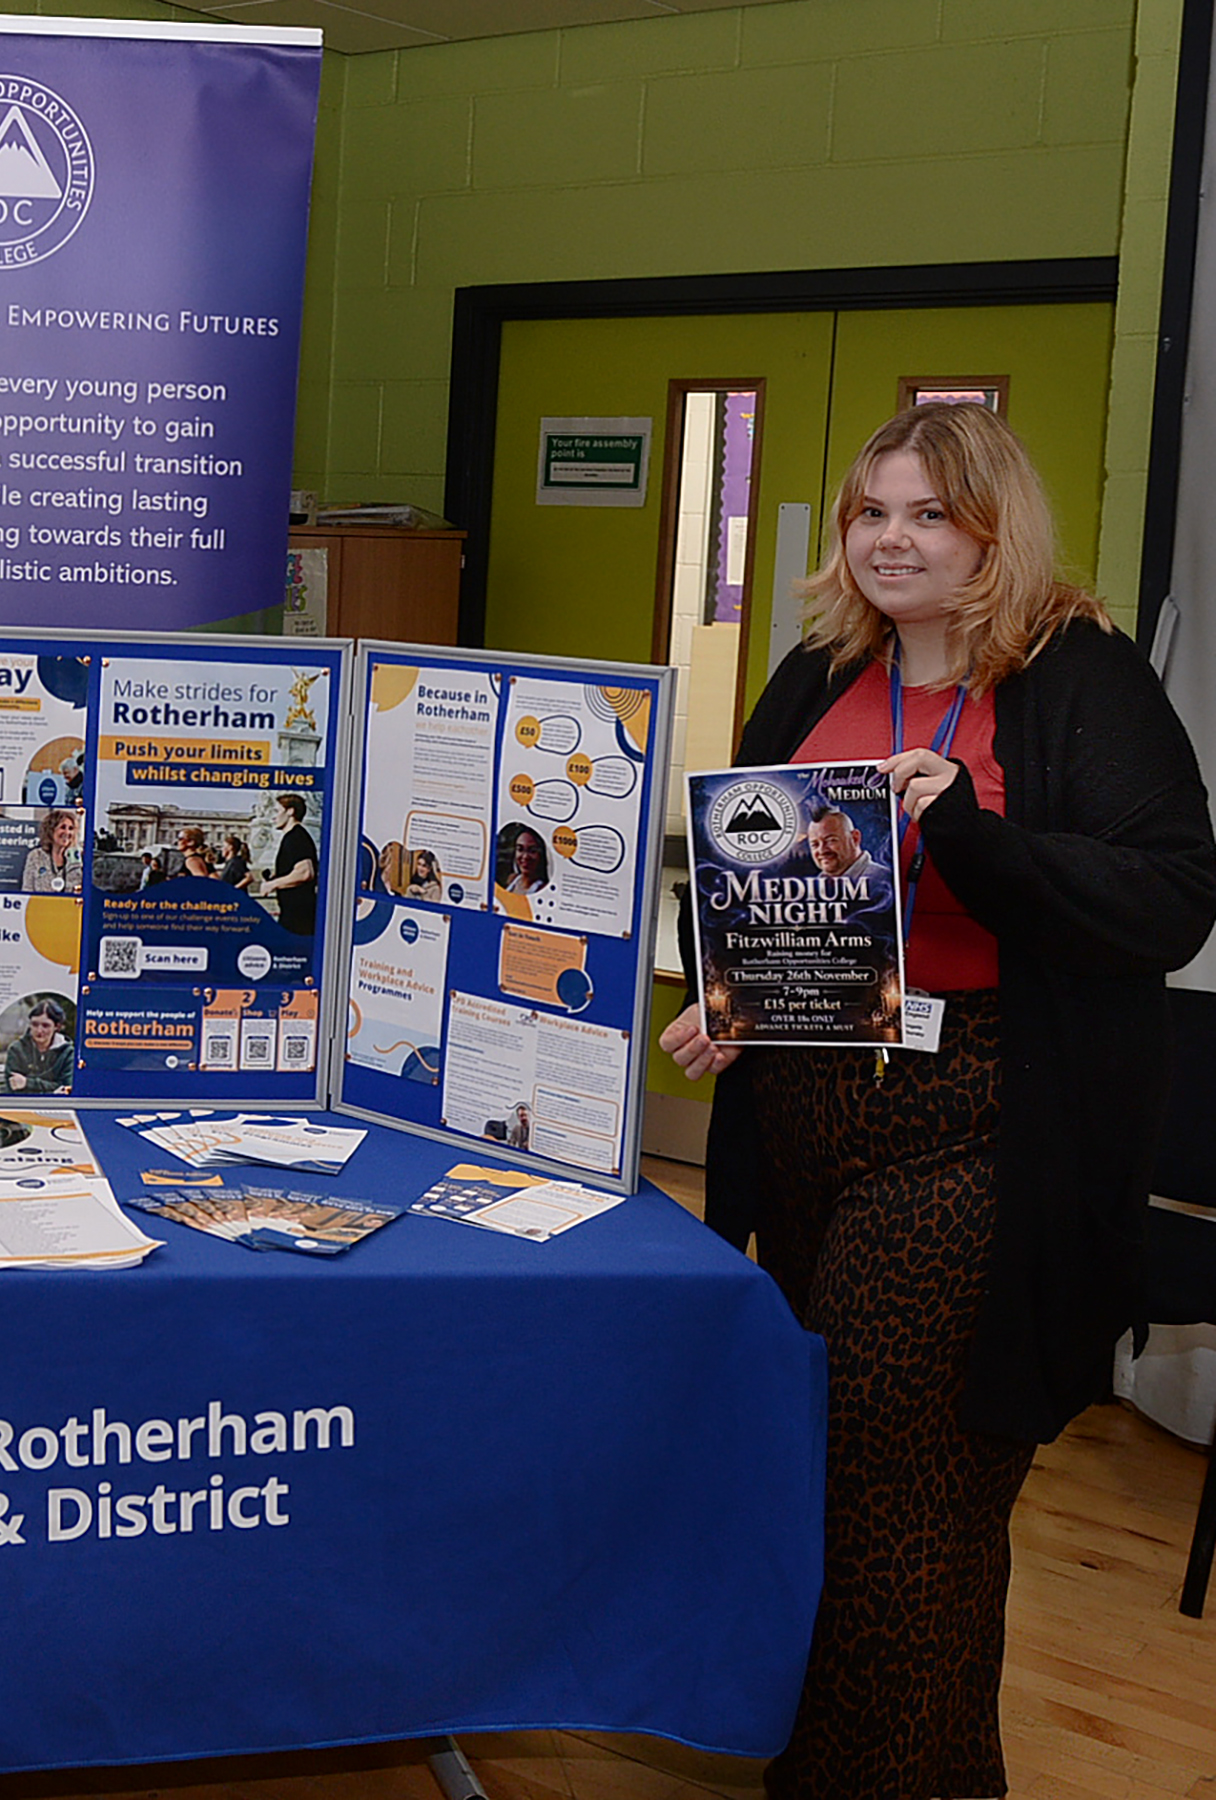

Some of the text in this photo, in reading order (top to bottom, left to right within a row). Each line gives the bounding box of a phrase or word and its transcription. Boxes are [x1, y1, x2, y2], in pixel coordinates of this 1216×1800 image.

[8, 304, 170, 332] EMPOWERING
[179, 311, 279, 336] FUTURES
[66, 378, 137, 403] young
[147, 380, 226, 406] person
[133, 416, 157, 436] to
[165, 417, 214, 443] gain
[551, 438, 638, 449] Your fire assembly
[551, 449, 585, 458] point is
[9, 448, 125, 472] successful
[135, 453, 242, 477] transition
[30, 487, 123, 514] creating
[132, 490, 208, 518] lasting
[29, 525, 121, 547] towards
[130, 527, 182, 549] their
[190, 528, 225, 551] full
[59, 562, 178, 587] ambitions.
[113, 680, 278, 703] Make strides for
[418, 685, 487, 704] Because in
[113, 703, 275, 729] Rotherham
[417, 703, 490, 722] Rotherham
[520, 726, 536, 737] £50
[115, 742, 262, 761] Push your limits
[132, 766, 314, 787] whilst changing lives
[568, 764, 590, 775] £100
[511, 784, 532, 795] £500
[828, 787, 886, 800] MEDIUM
[26, 824, 35, 834] in
[737, 832, 771, 845] ROC
[710, 869, 870, 911] MEDIUM
[3, 897, 22, 910] be
[104, 899, 239, 913] Ready for the challenge?
[748, 902, 848, 925] NIGHT
[725, 931, 872, 949] Fitzwilliam Arms
[145, 954, 198, 964] Scan here
[360, 957, 413, 977] Training and
[359, 968, 435, 994] Workplace Advice
[732, 970, 869, 983] Thursday 26th November
[243, 992, 251, 1002] 2
[281, 992, 289, 1003] 3
[358, 979, 412, 1001] Programmes
[782, 986, 819, 998] 7-9pm
[242, 1009, 263, 1017] Shop
[764, 999, 841, 1012] £15 per ticket
[86, 1009, 103, 1018] Help
[116, 1011, 144, 1019] support
[146, 1010, 159, 1018] the
[160, 1011, 185, 1020] people
[771, 1015, 795, 1023] OVER
[811, 1015, 835, 1023] ONLY
[85, 1019, 194, 1036] Rotherham
[48, 1475, 290, 1542] District
